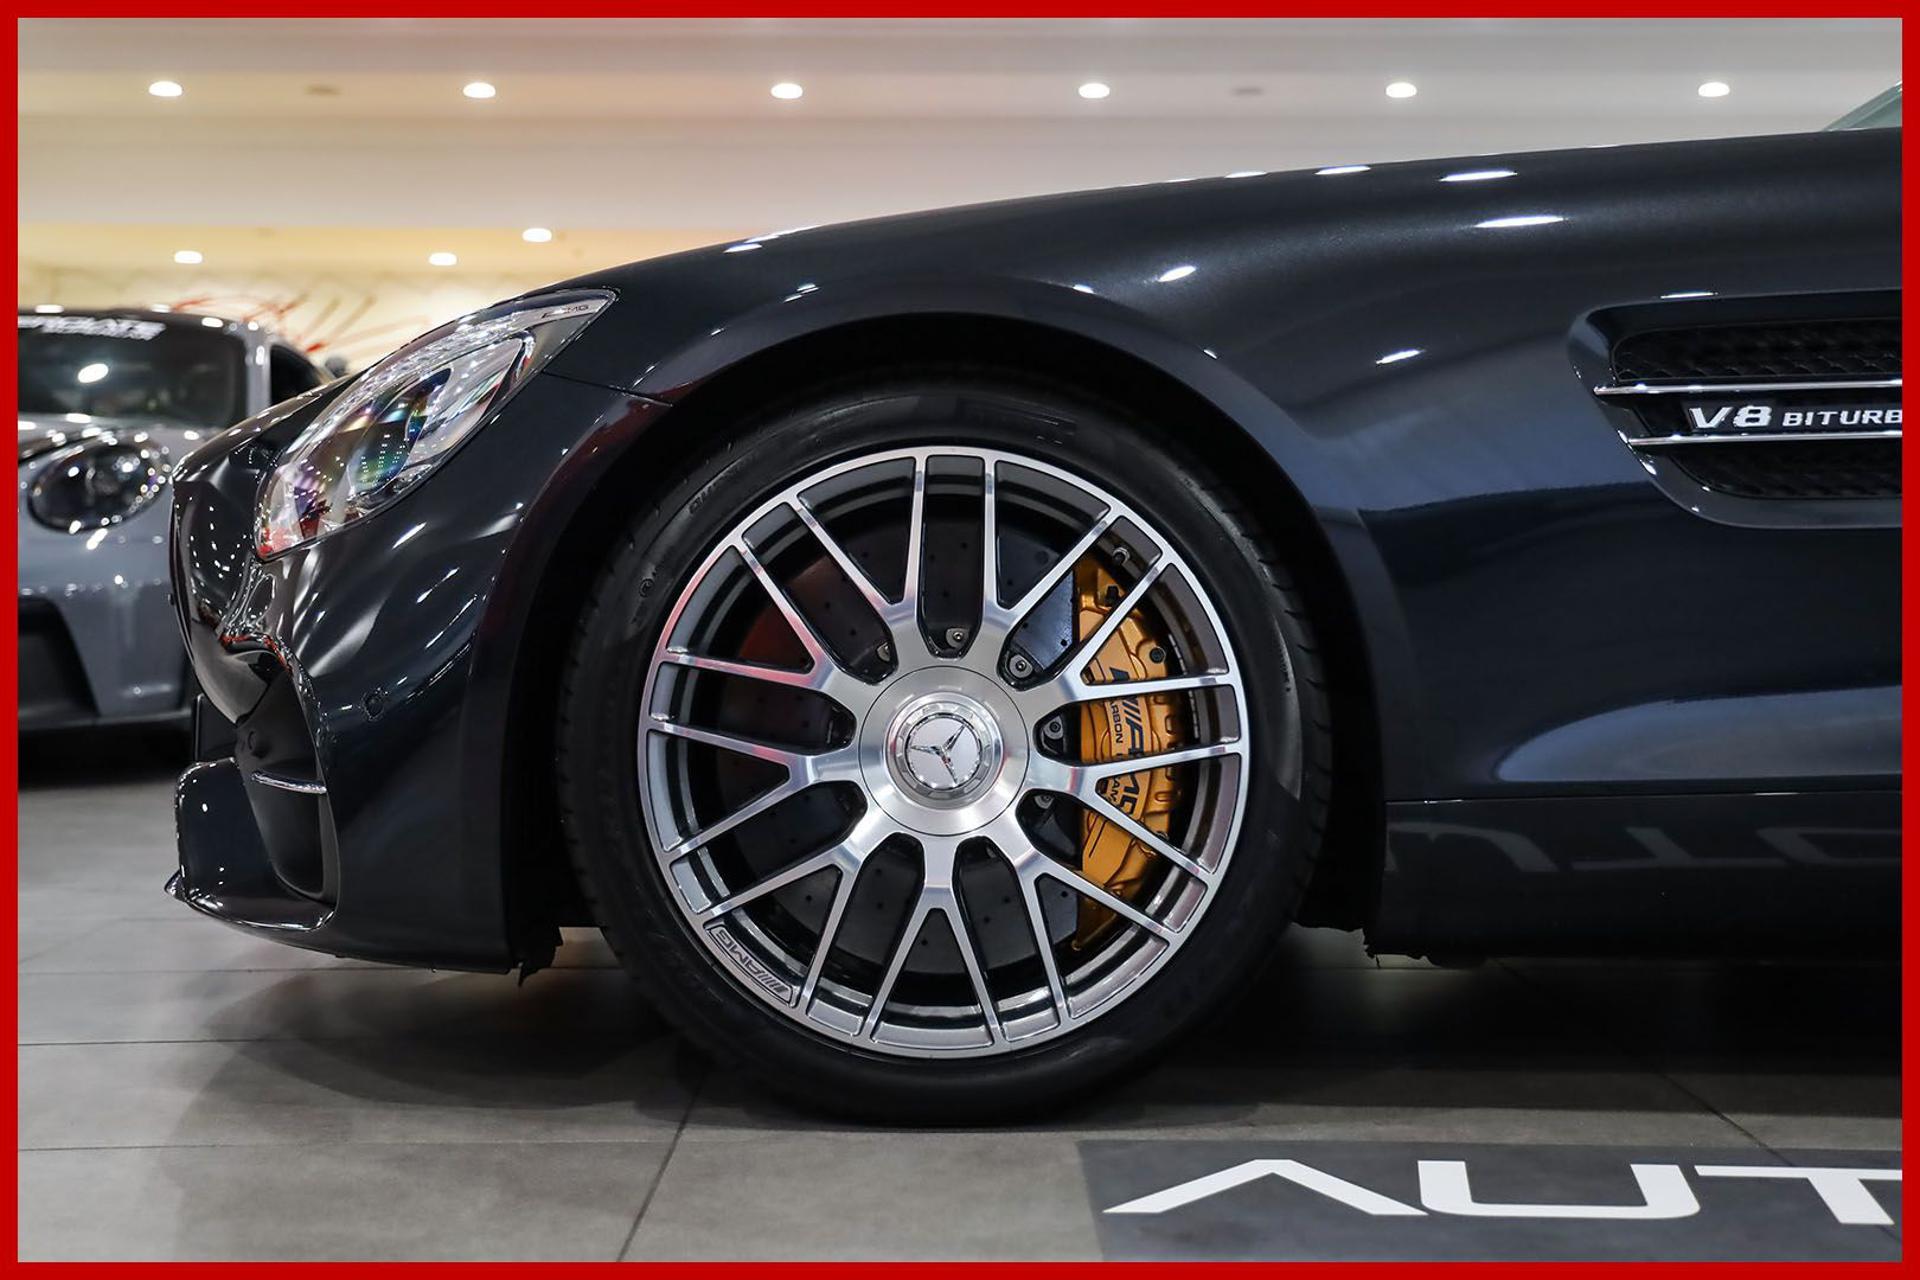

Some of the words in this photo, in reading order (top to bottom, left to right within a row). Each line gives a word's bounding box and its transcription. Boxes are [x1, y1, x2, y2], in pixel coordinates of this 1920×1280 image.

[1689, 405, 1773, 429] V8
[1782, 409, 1902, 427] BITURB
[716, 929, 765, 976] AMG
[1103, 1159, 1902, 1225] AUT
